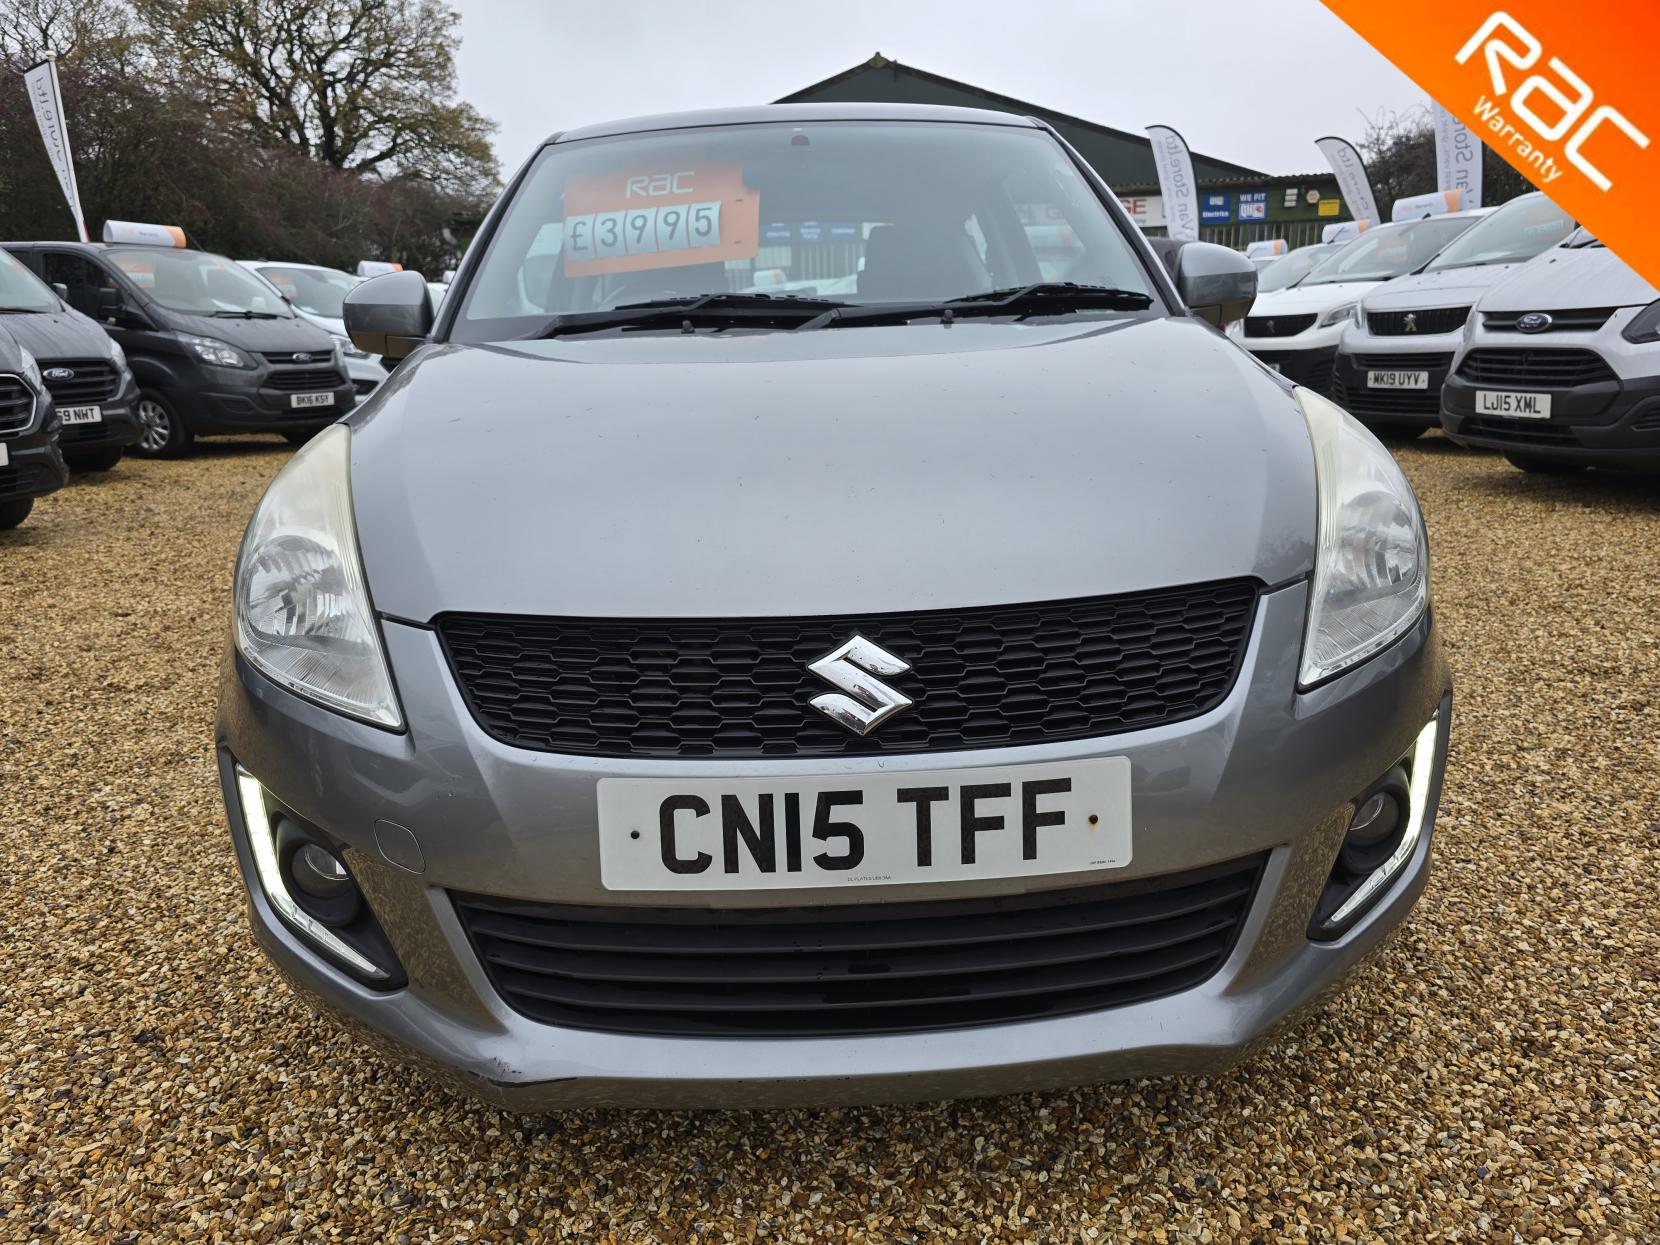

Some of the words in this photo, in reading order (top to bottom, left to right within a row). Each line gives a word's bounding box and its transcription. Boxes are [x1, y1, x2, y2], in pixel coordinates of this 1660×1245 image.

[570, 206, 713, 251] £3995
[1483, 394, 1511, 412] LJ15
[1514, 396, 1541, 414] XML
[659, 789, 865, 875] CN15
[896, 778, 1073, 867] TFF
